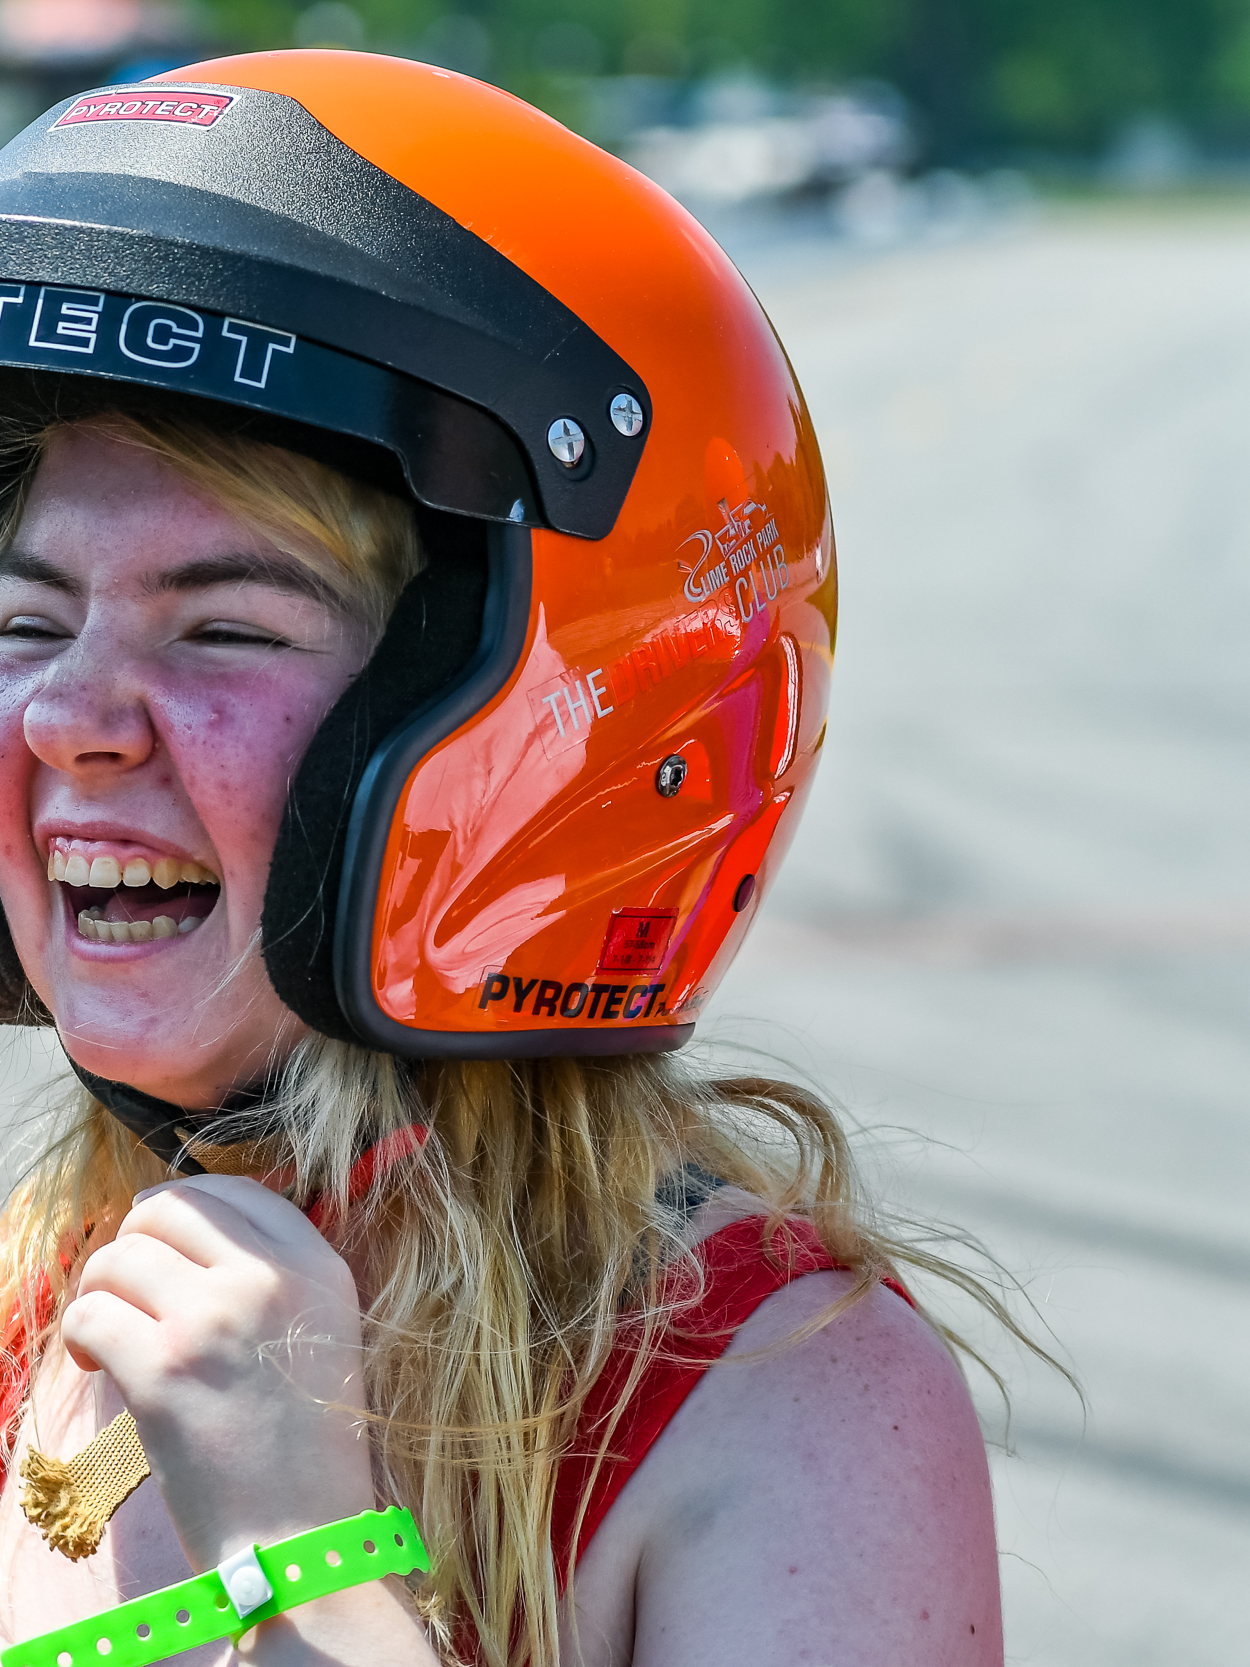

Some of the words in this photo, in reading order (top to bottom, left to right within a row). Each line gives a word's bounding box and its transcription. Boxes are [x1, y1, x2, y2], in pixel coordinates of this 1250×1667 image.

[65, 100, 219, 120] PYROTECT
[700, 561, 730, 597] LIME
[729, 539, 757, 576] ROCK
[756, 518, 780, 554] PARK
[542, 668, 614, 738] THE
[735, 544, 790, 623] CLUB
[636, 921, 651, 938] M
[478, 972, 666, 1020] PYROTECT
